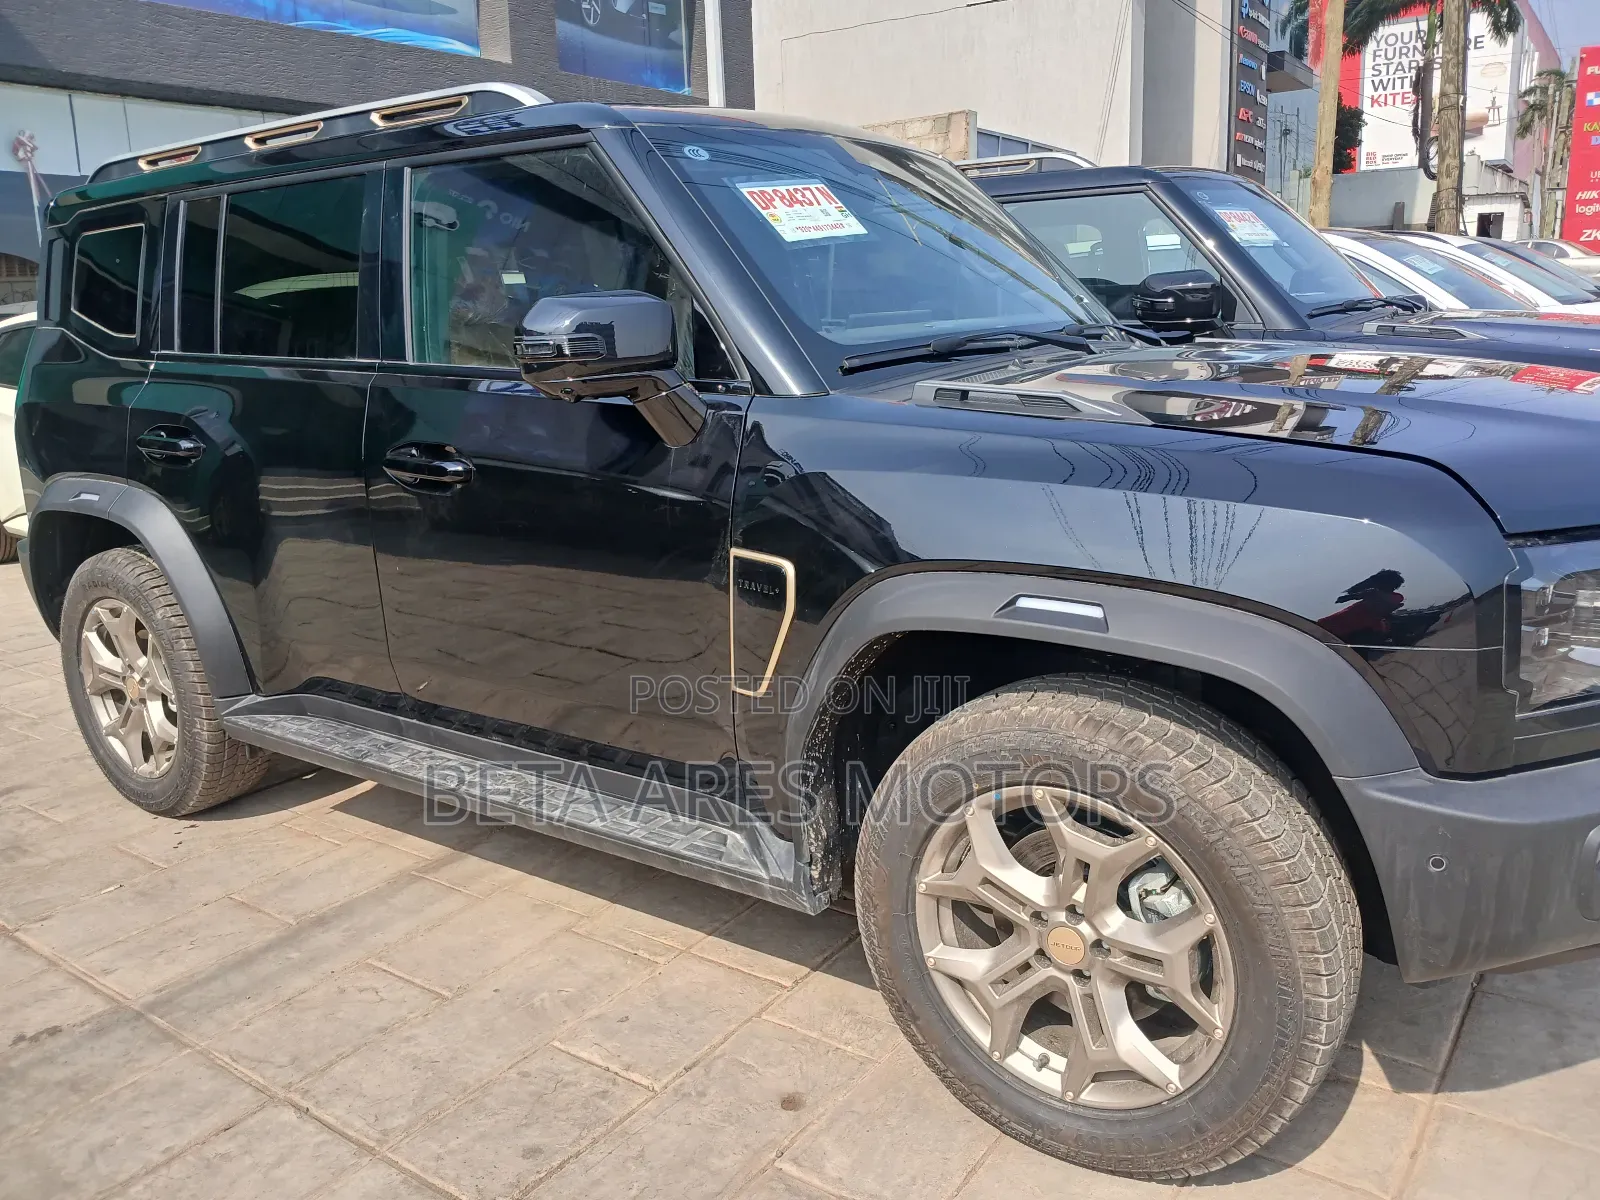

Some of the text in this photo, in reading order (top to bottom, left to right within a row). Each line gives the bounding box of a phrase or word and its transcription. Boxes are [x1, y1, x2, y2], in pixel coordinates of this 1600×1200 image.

[1374, 30, 1427, 49] YOUR
[1371, 57, 1442, 77] STARS
[1240, 81, 1256, 97] EPSON
[1583, 122, 1600, 132] KA
[747, 187, 839, 210] DP 8437 N
